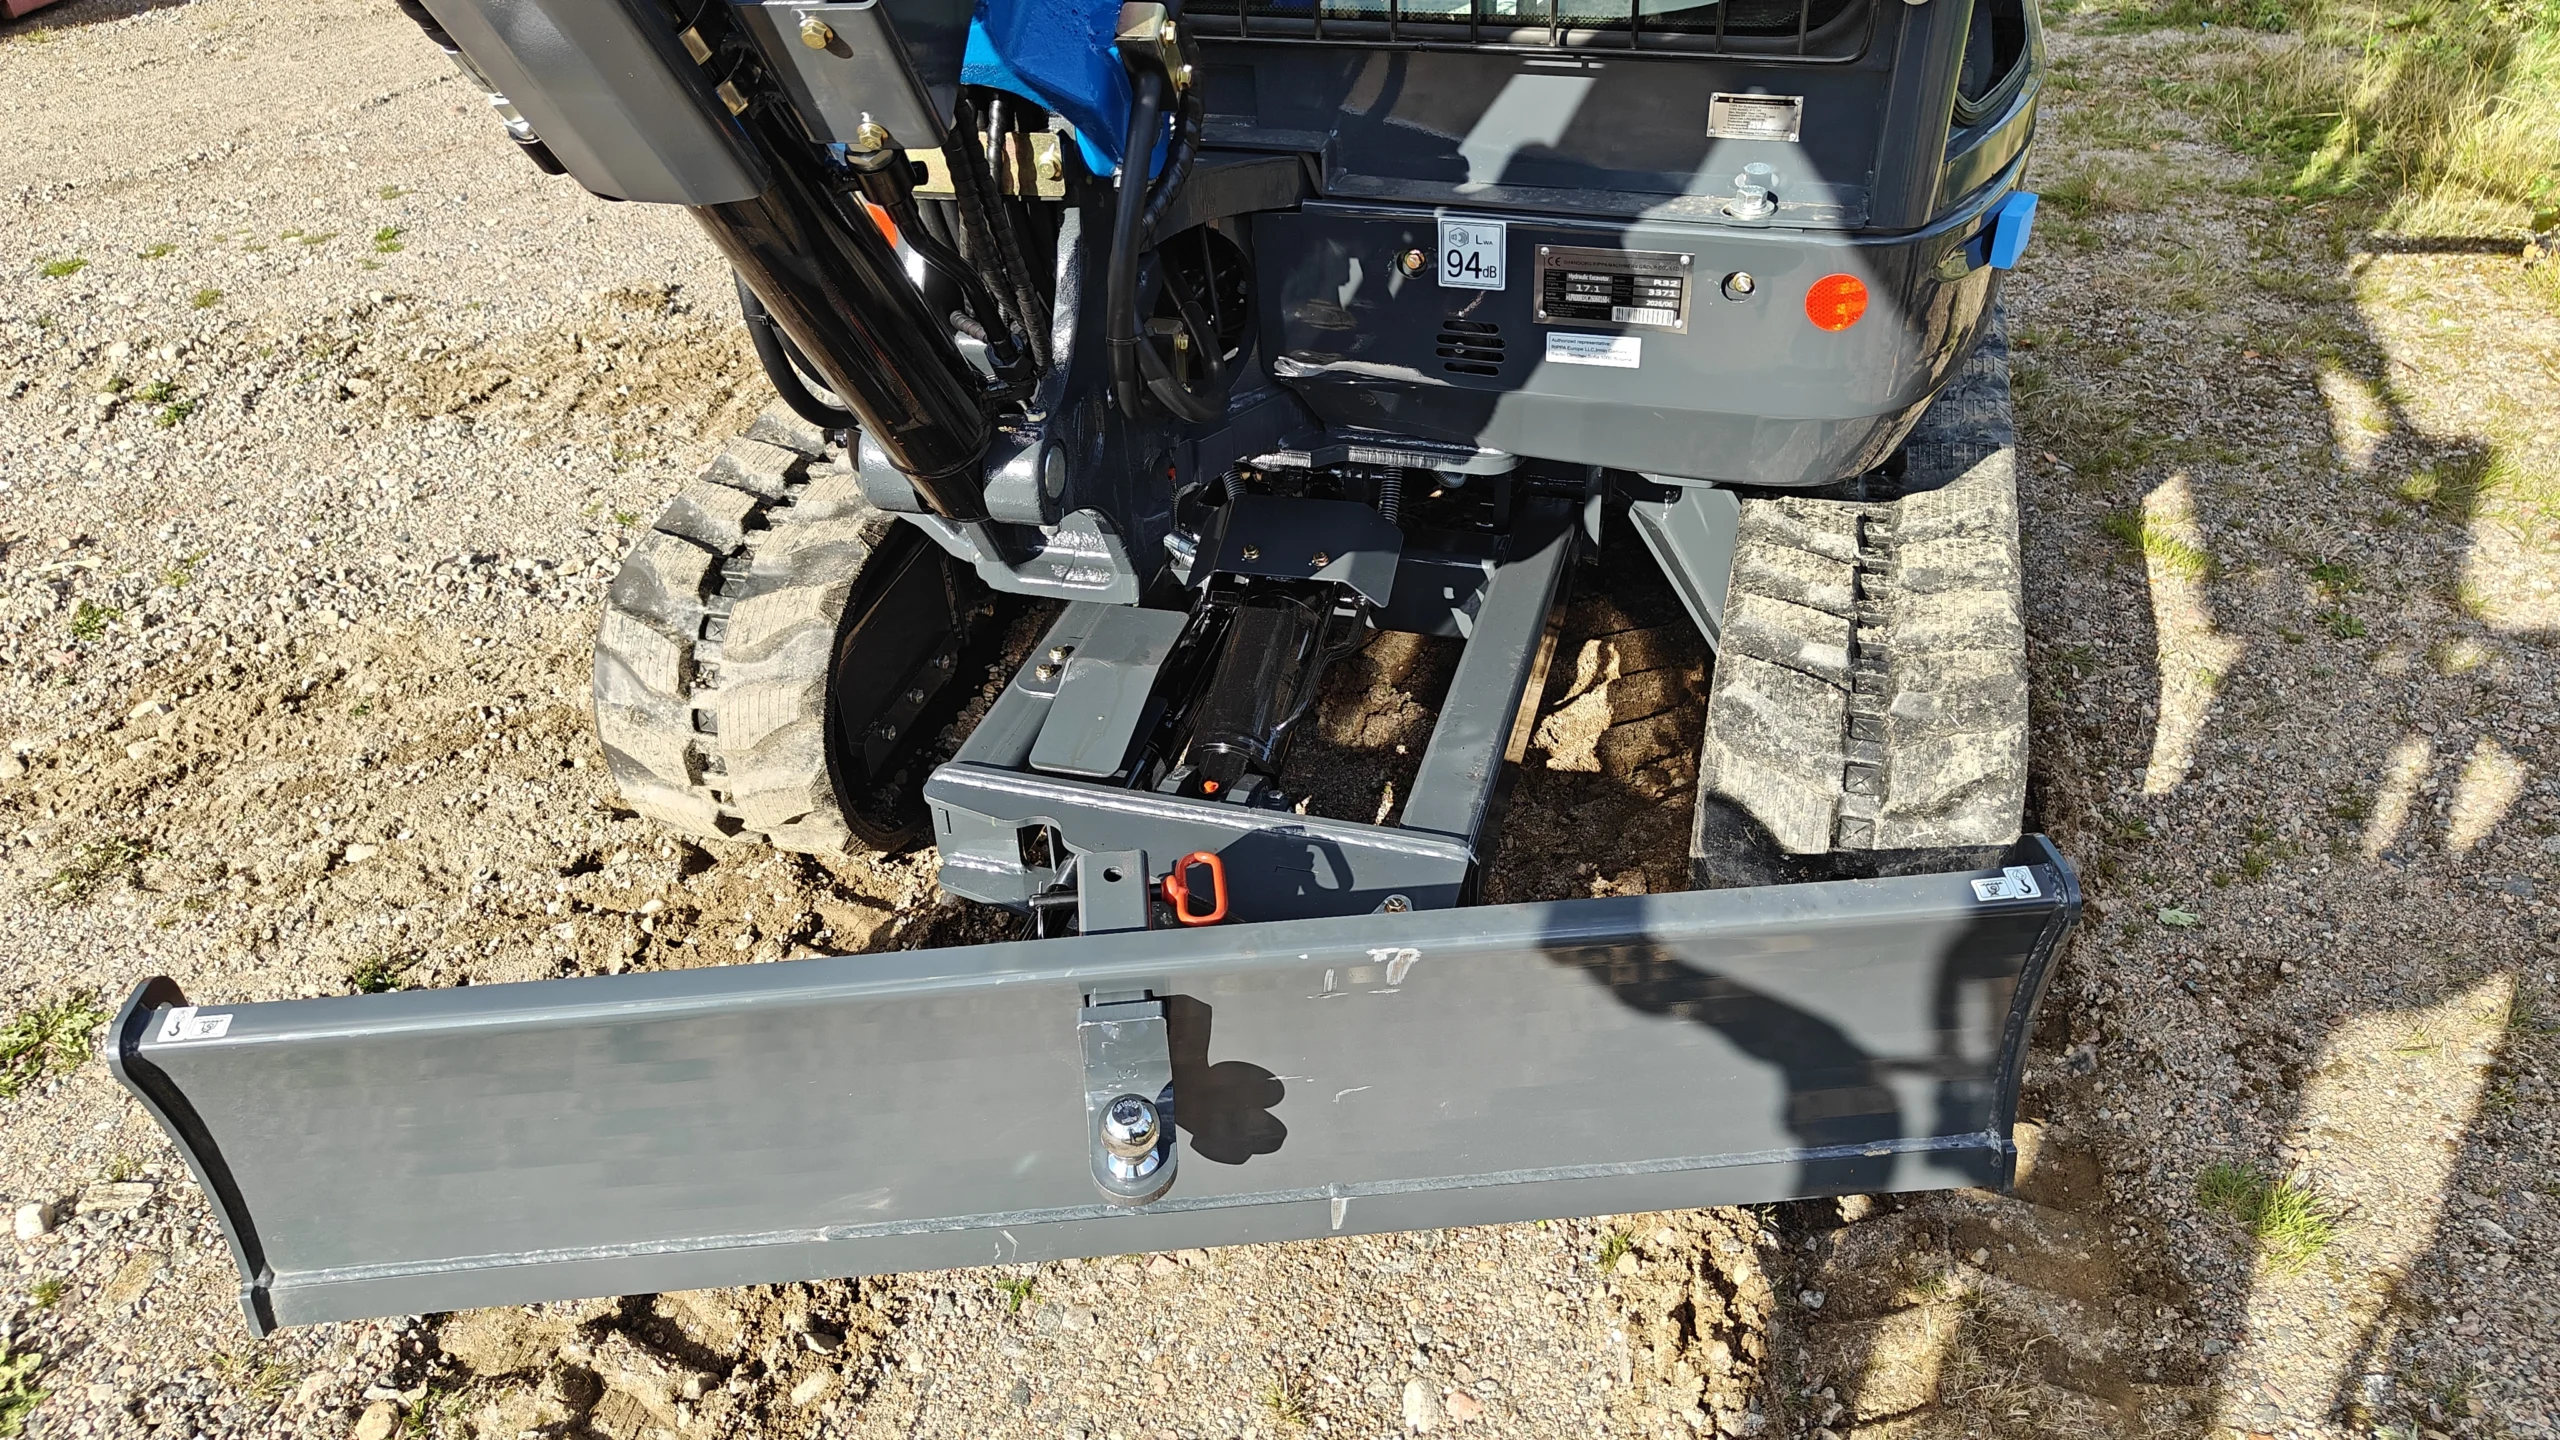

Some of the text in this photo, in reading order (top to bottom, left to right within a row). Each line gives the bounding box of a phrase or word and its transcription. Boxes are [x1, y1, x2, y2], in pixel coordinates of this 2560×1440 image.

[1568, 273, 1610, 282] Hydraulic Excavator
[1653, 278, 1679, 288] R32
[1575, 284, 1601, 293] 17.1
[1647, 288, 1676, 298] 3371
